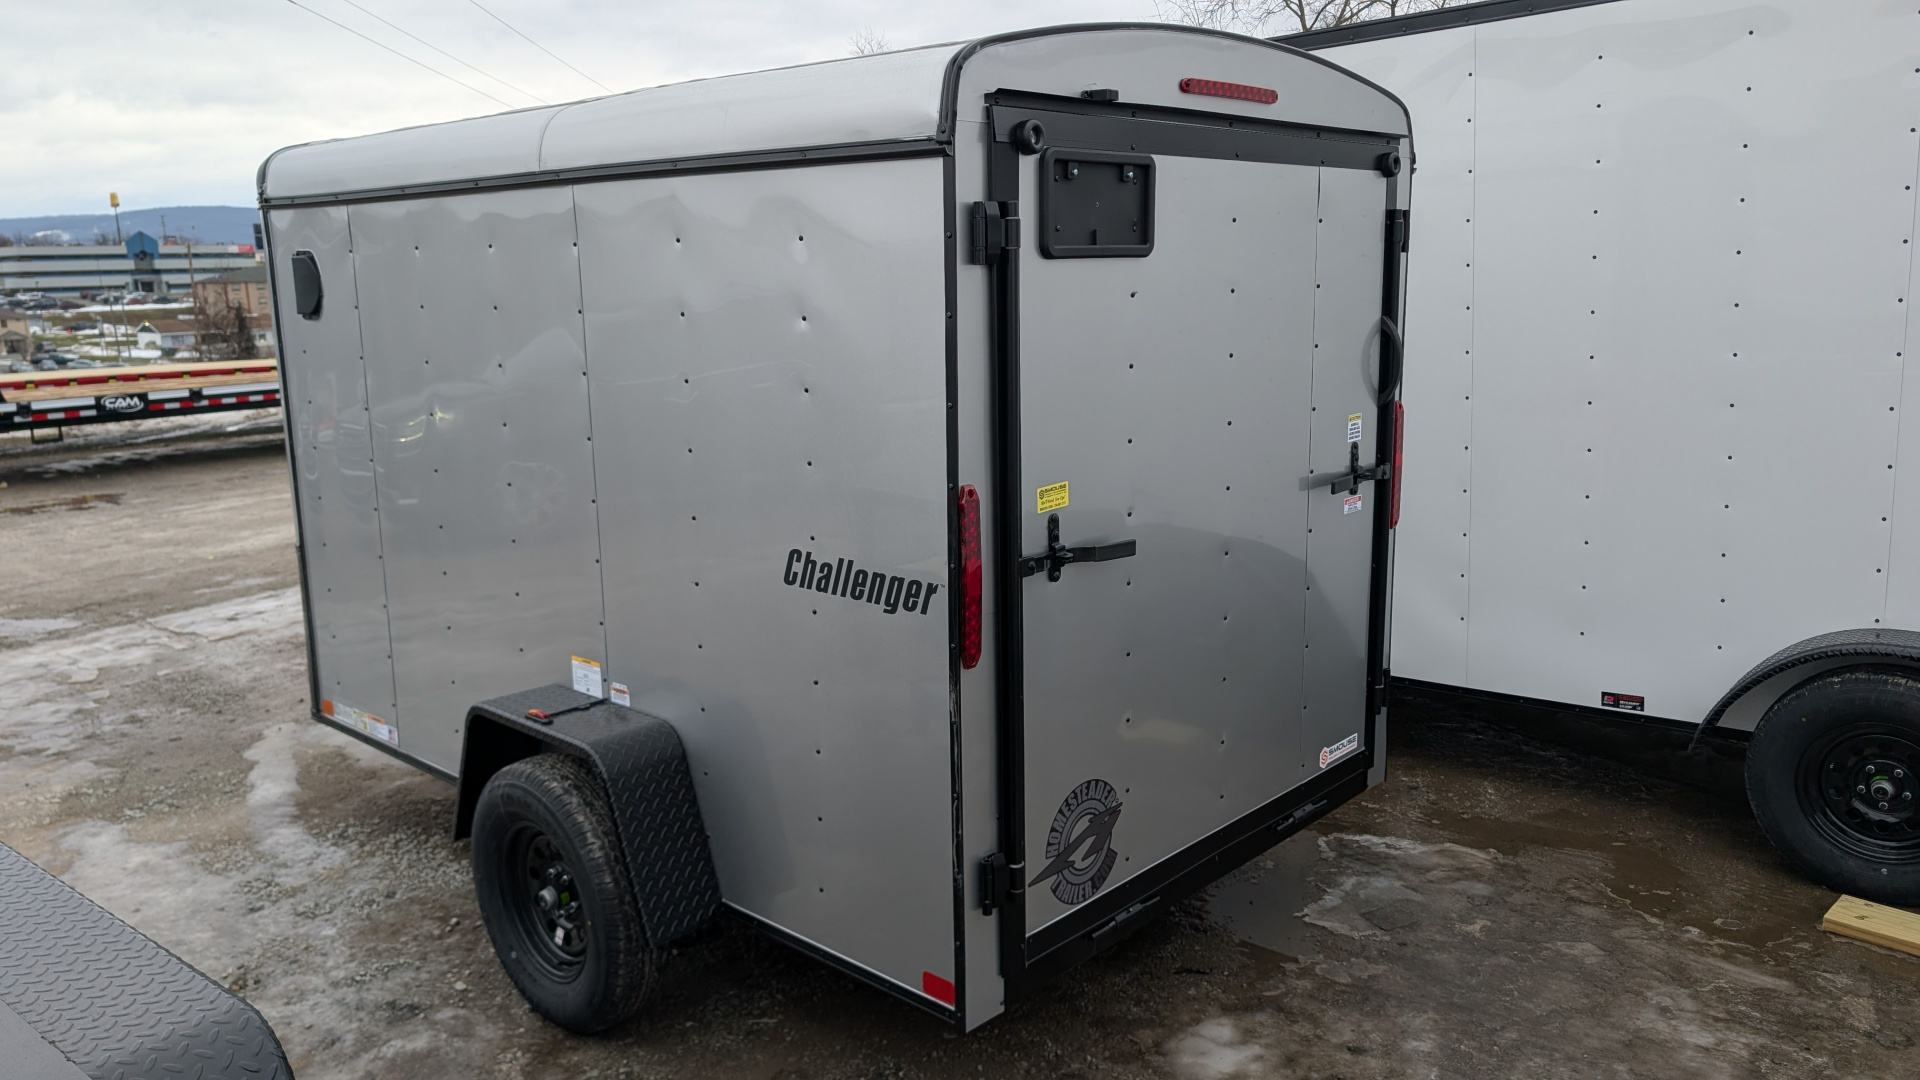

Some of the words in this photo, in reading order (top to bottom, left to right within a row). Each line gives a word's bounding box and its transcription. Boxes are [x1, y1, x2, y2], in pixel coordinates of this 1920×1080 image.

[105, 396, 140, 409] CAM
[783, 548, 939, 616] Challenger
[1329, 735, 1356, 756] SMOUSE
[1046, 779, 1117, 859] HOMESTEADER
[1050, 848, 1117, 904] TRAILER.COM
